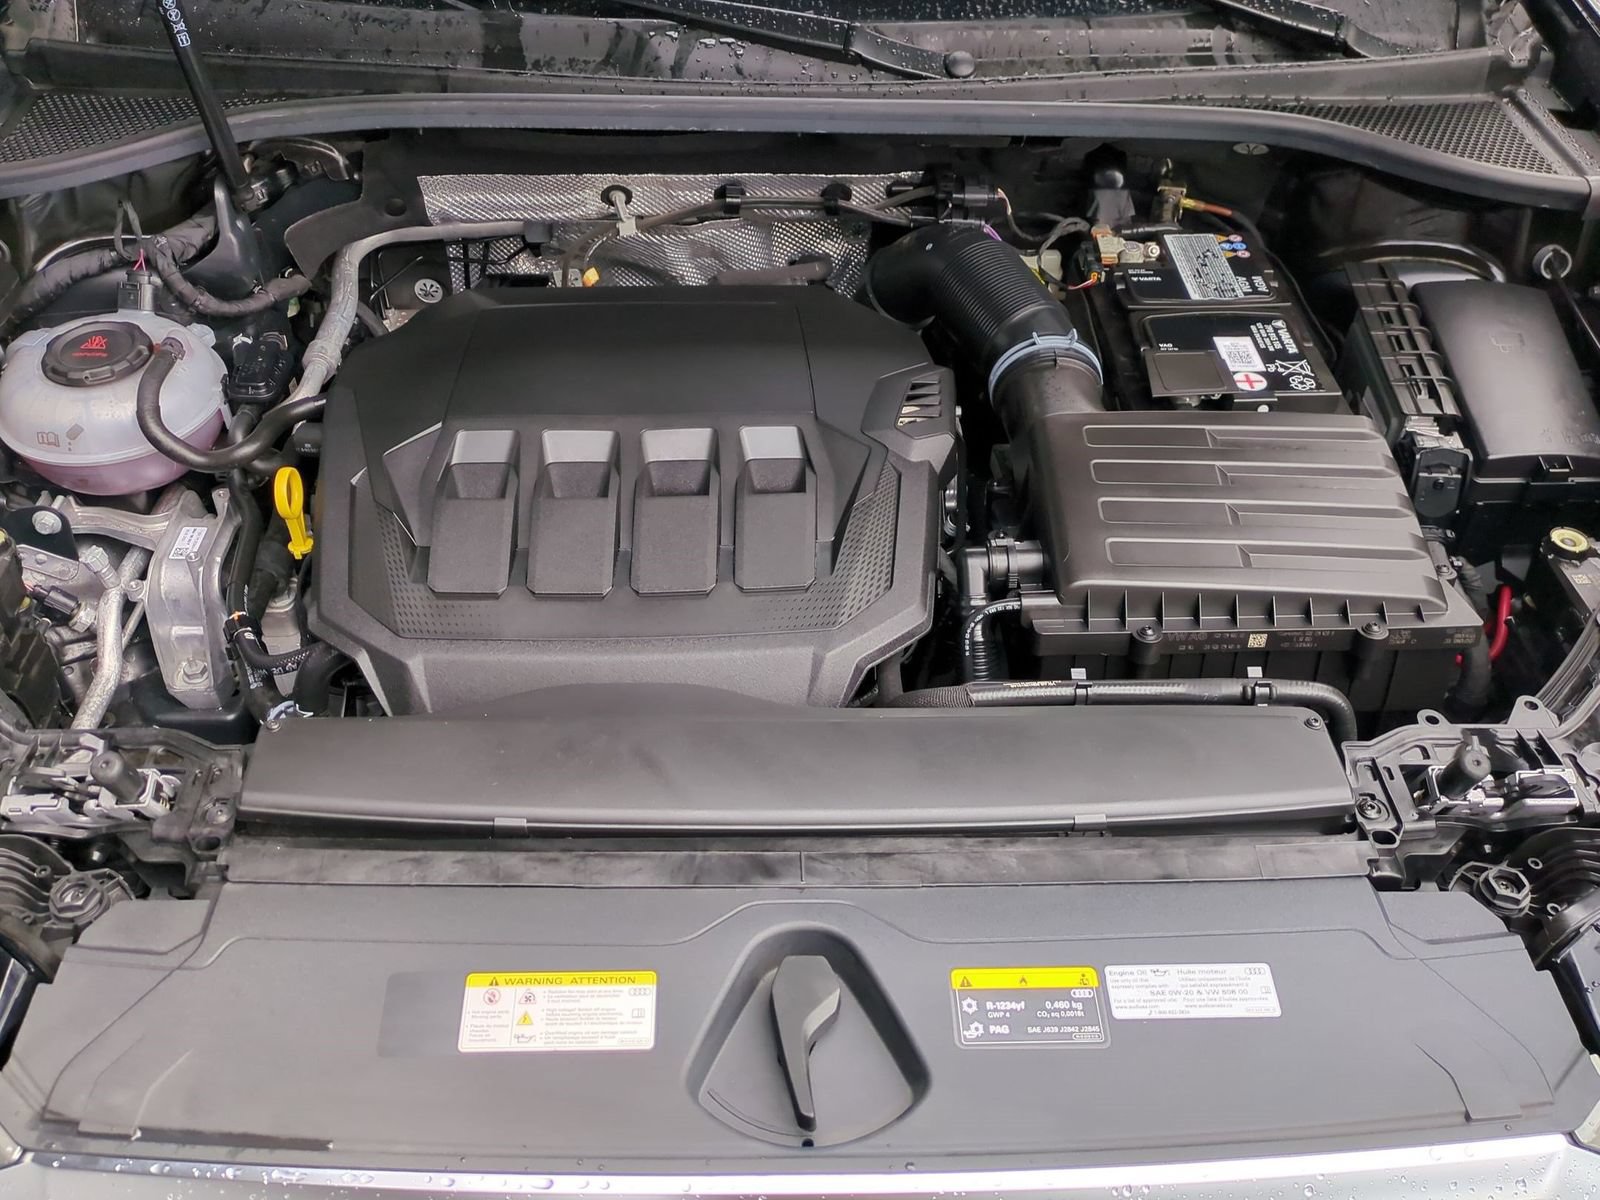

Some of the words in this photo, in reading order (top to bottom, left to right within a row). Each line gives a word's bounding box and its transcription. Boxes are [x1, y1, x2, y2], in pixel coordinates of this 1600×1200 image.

[1277, 328, 1299, 354] VARTA
[1108, 969, 1135, 977] Engine
[504, 977, 563, 986] WARNING
[570, 976, 636, 985] ATTENTION
[986, 1000, 1025, 1011] R-1234yf
[1071, 1000, 1083, 1010] kg
[989, 1025, 1010, 1034] PAG
